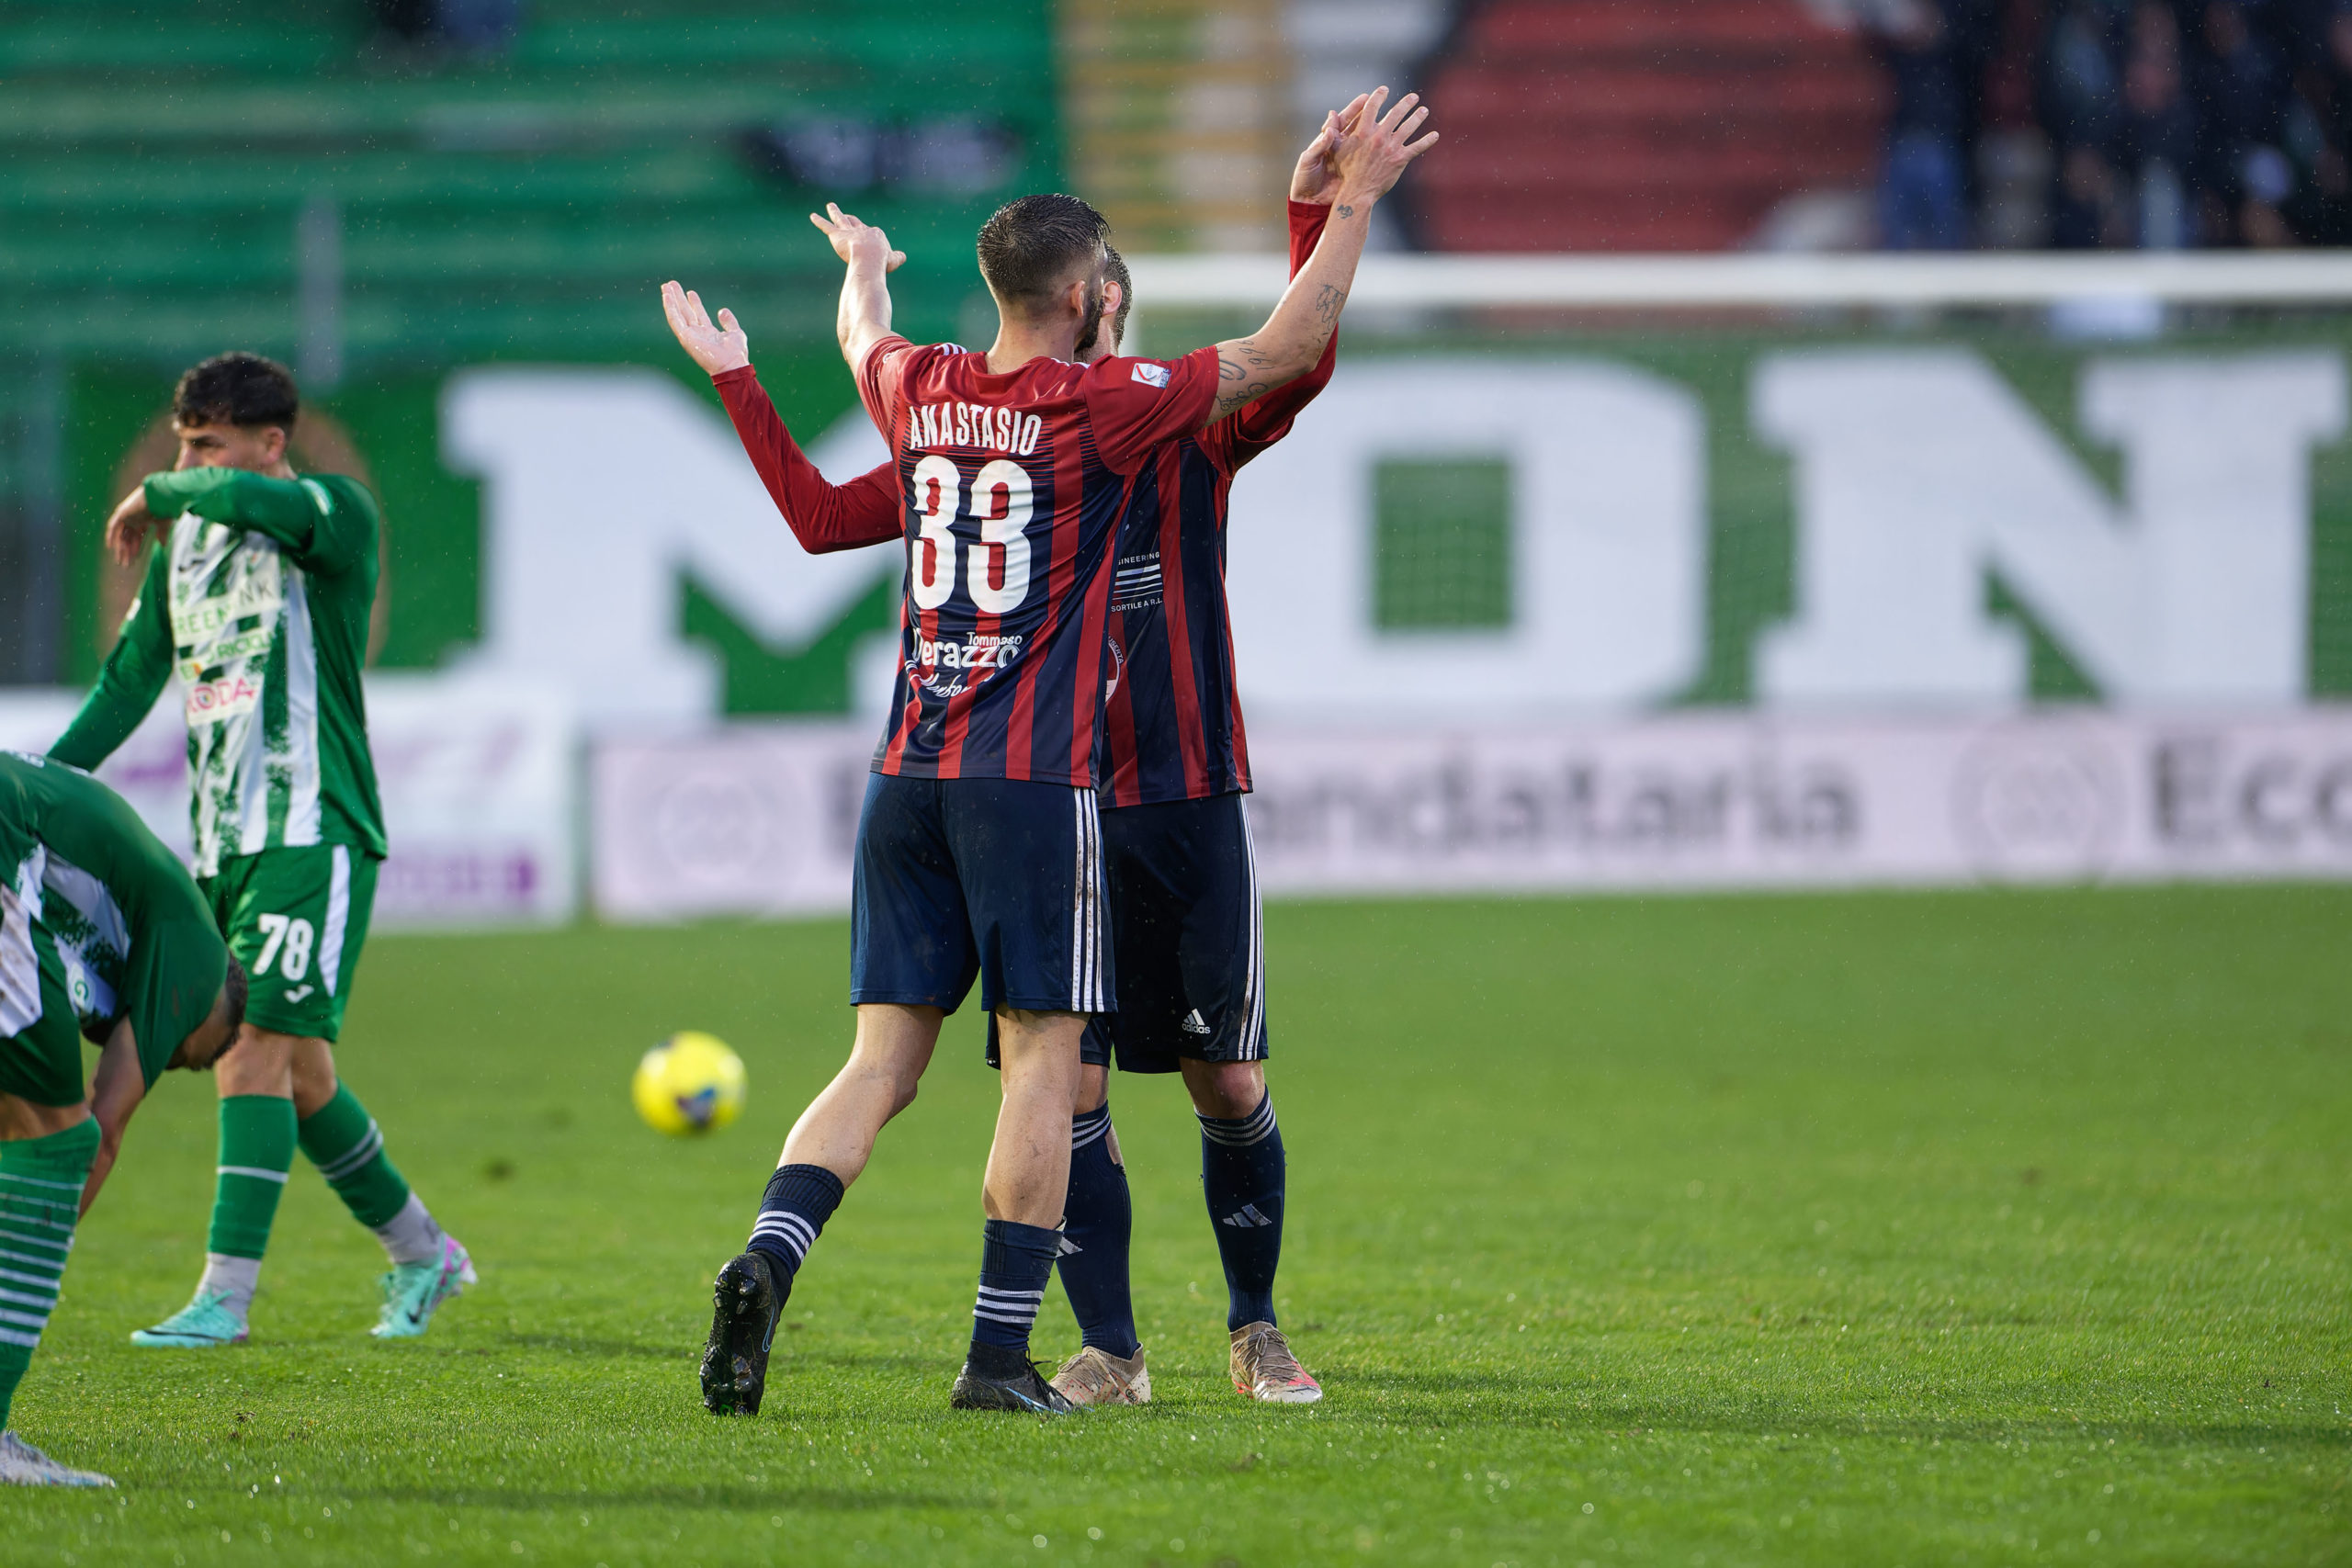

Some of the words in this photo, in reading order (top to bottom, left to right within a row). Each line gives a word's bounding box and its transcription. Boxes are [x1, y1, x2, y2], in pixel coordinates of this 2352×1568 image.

[910, 401, 1042, 457] ANASTASIO
[911, 455, 1034, 614] 33
[1118, 551, 1160, 566] INEERING
[966, 631, 1023, 647] Tommaso
[252, 912, 314, 982] 78
[1182, 1022, 1211, 1034] adidas
